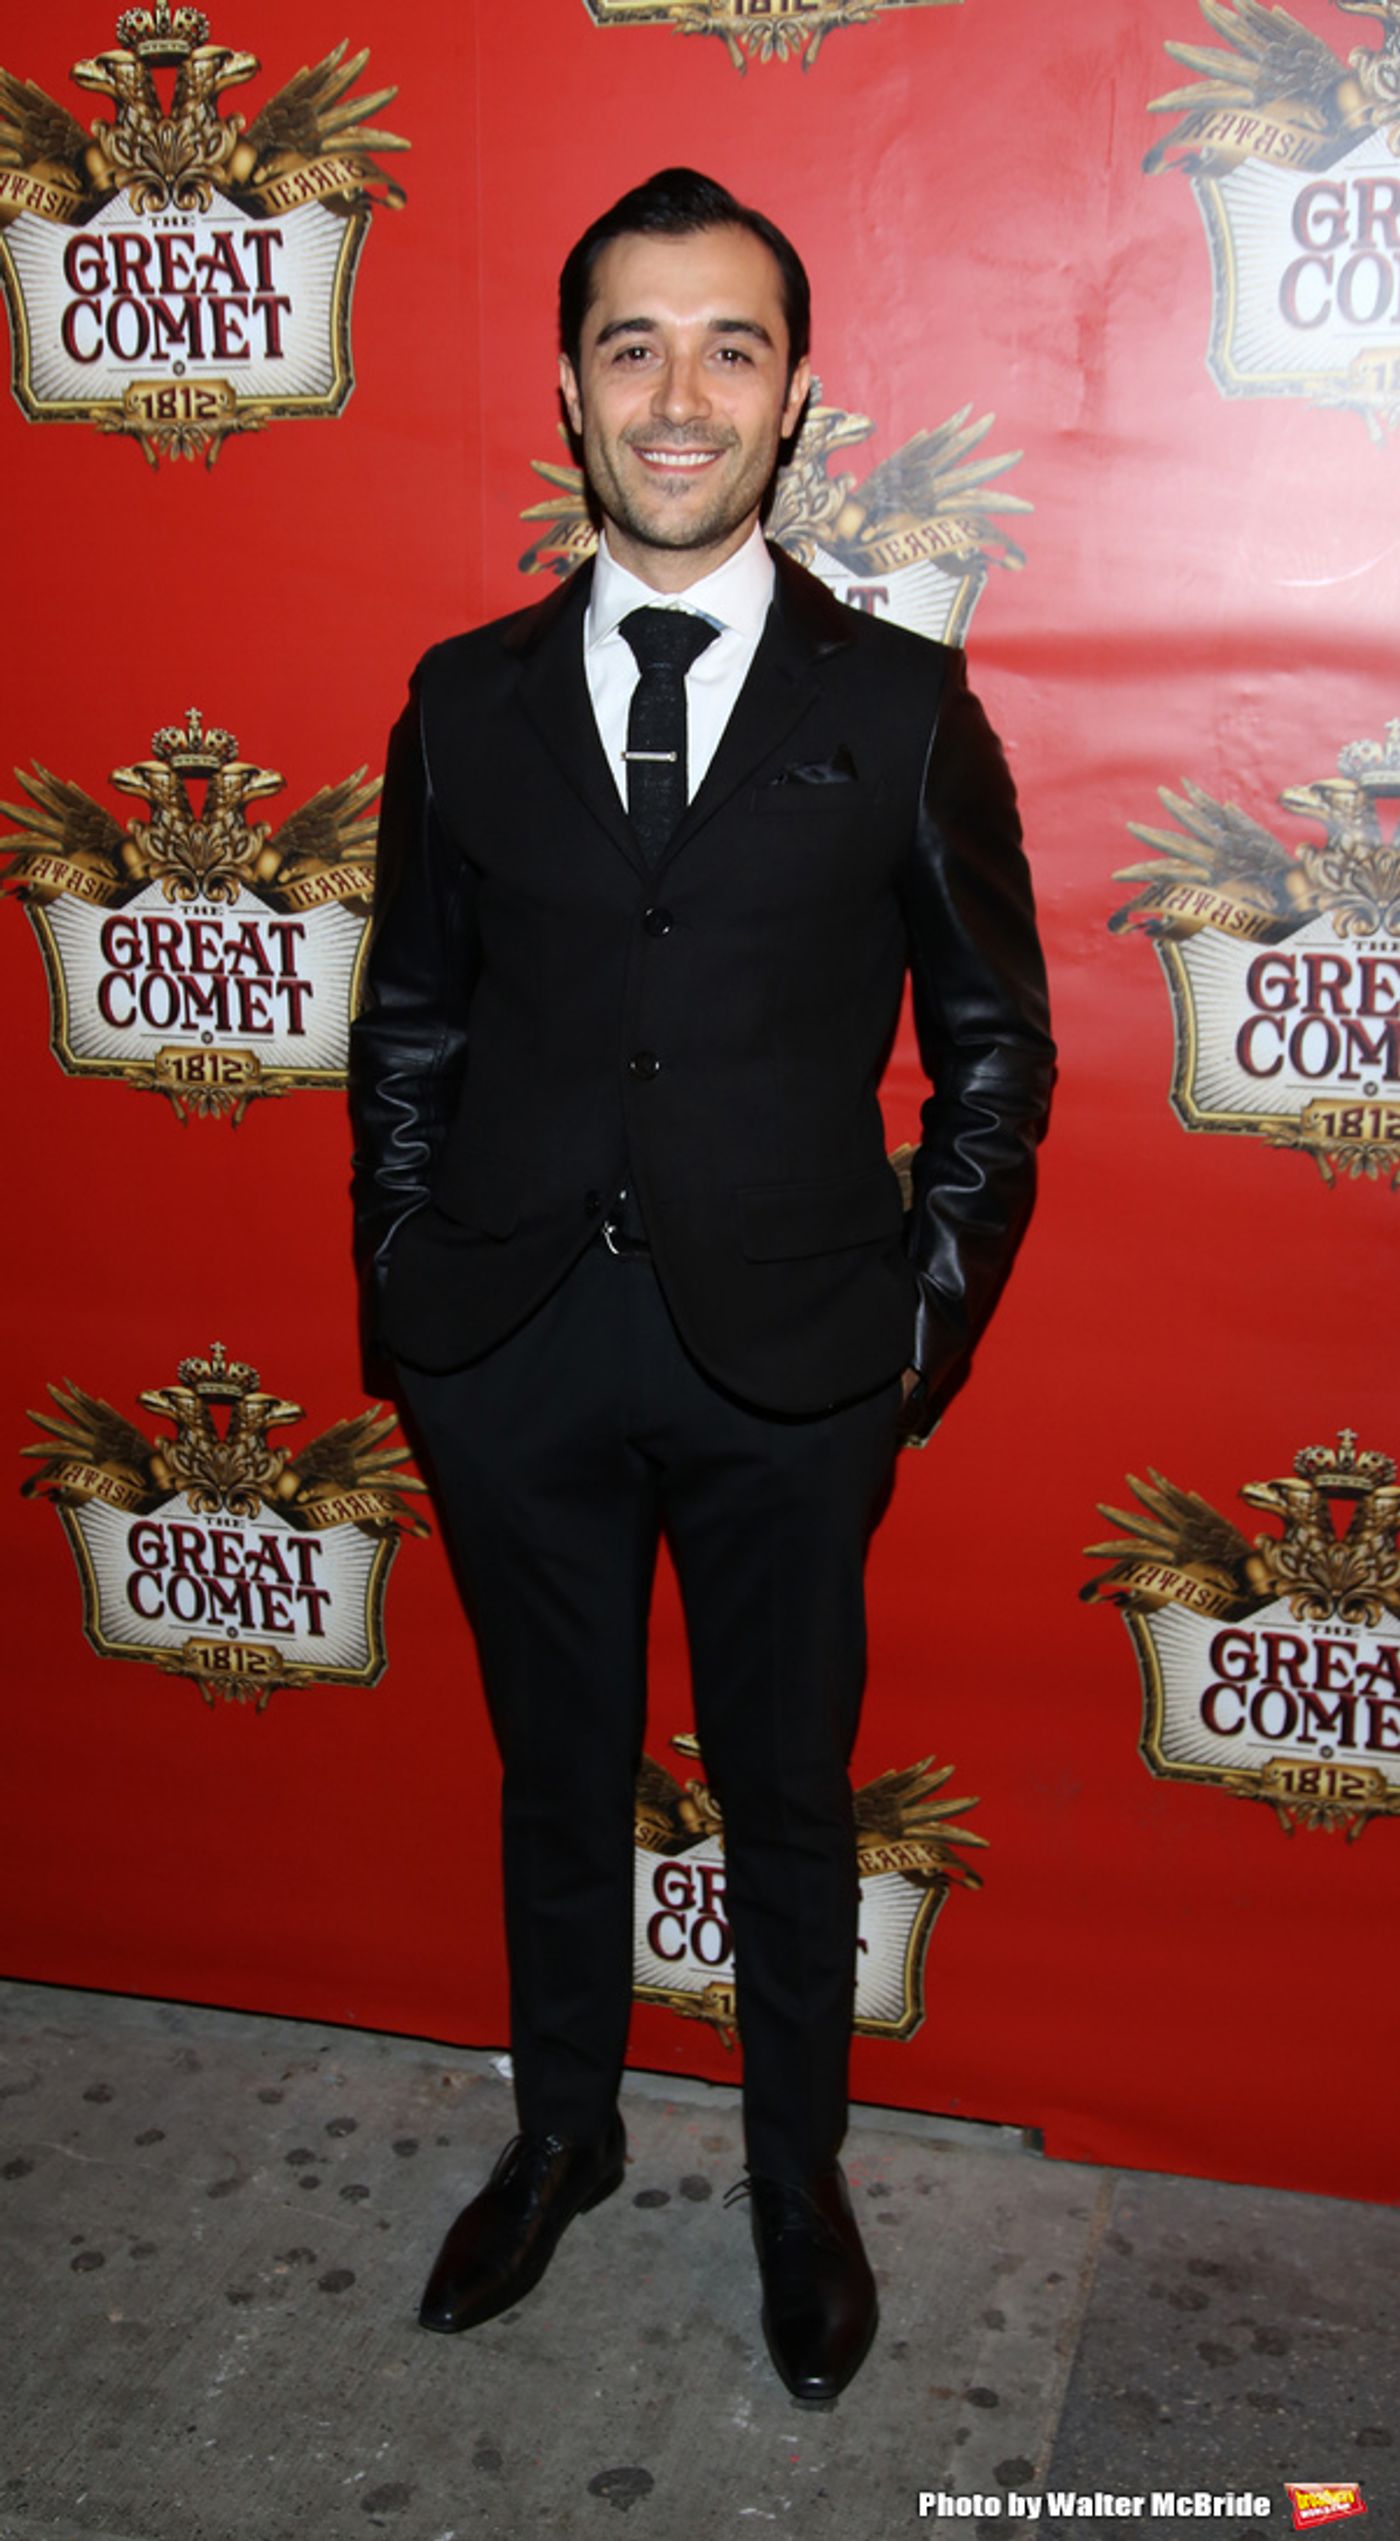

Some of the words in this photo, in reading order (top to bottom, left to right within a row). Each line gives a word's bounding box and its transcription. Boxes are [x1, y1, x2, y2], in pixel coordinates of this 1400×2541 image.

[148, 216, 196, 228] THE
[63, 229, 283, 297] GREAT
[61, 296, 292, 364] COMET
[139, 386, 219, 419] 1812
[180, 905, 224, 916] THE
[100, 915, 305, 977] GREAT
[98, 970, 313, 1035] COMET
[169, 1053, 243, 1084] 1812
[204, 1516, 245, 1529] THE
[129, 1521, 322, 1587] GREAT
[127, 1571, 332, 1636] COMET
[1308, 1624, 1359, 1639] THE
[200, 1646, 270, 1675] 1812
[1281, 1769, 1366, 1799] 1812
